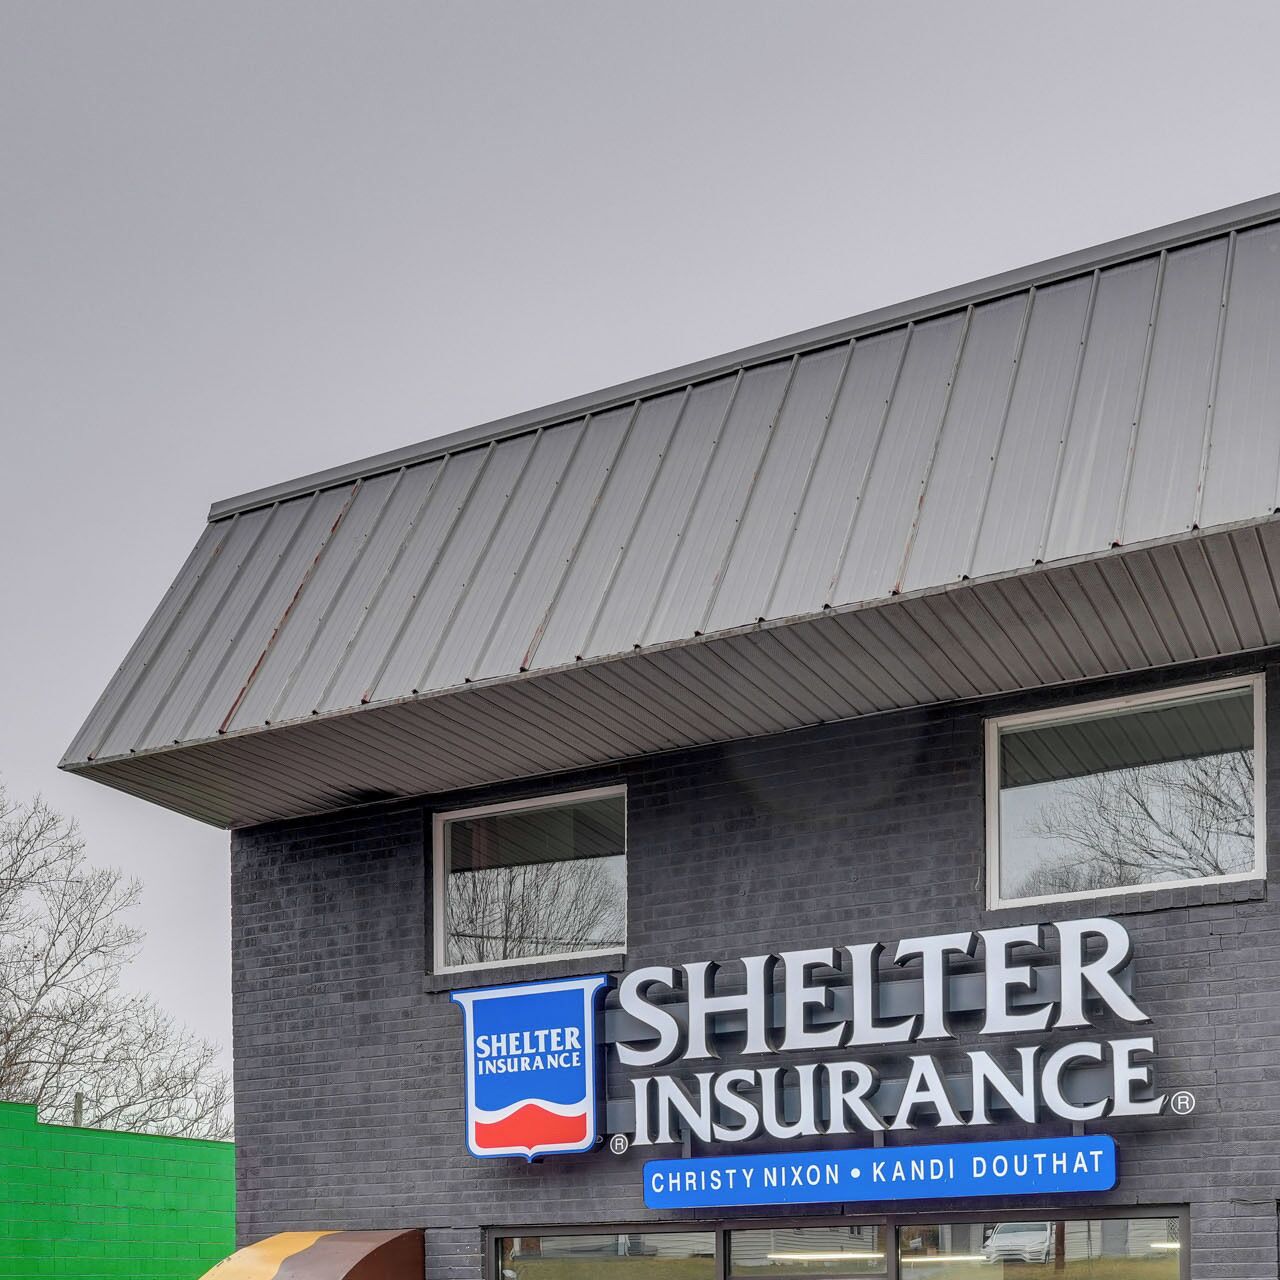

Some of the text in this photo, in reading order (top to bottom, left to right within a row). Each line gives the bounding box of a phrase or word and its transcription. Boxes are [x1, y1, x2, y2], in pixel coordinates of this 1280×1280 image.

[615, 916, 1152, 1067] SHELTER
[476, 1027, 582, 1058] SHELTER
[478, 1052, 581, 1075] INSURANCE
[630, 1036, 1169, 1147] INSURANCE
[651, 1150, 1104, 1193] CHRISTY NIXON KANDI DOUTHAT
